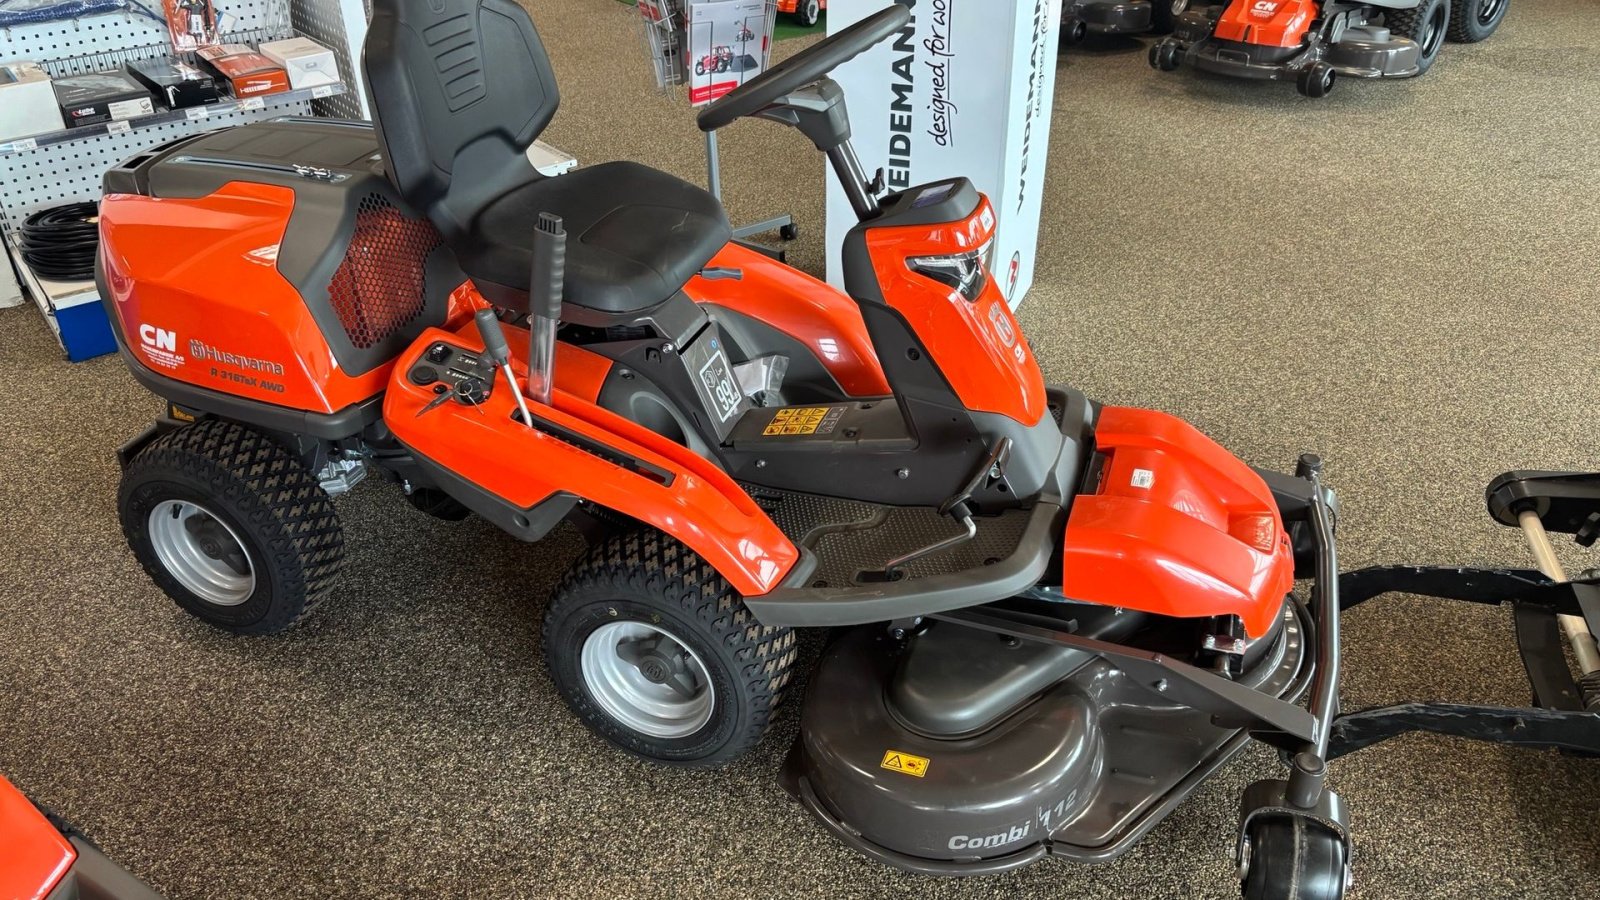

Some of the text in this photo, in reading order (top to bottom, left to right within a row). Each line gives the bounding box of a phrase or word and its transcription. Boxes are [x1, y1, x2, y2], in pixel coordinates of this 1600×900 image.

[1254, 1, 1278, 12] CN
[923, 24, 955, 57] for
[925, 61, 958, 147] designed
[139, 323, 176, 352] CN
[205, 344, 284, 376] Husqvarna
[210, 367, 218, 377] R
[259, 379, 285, 394] AWD
[716, 379, 735, 411] 99
[948, 788, 1077, 850] Combi 112
